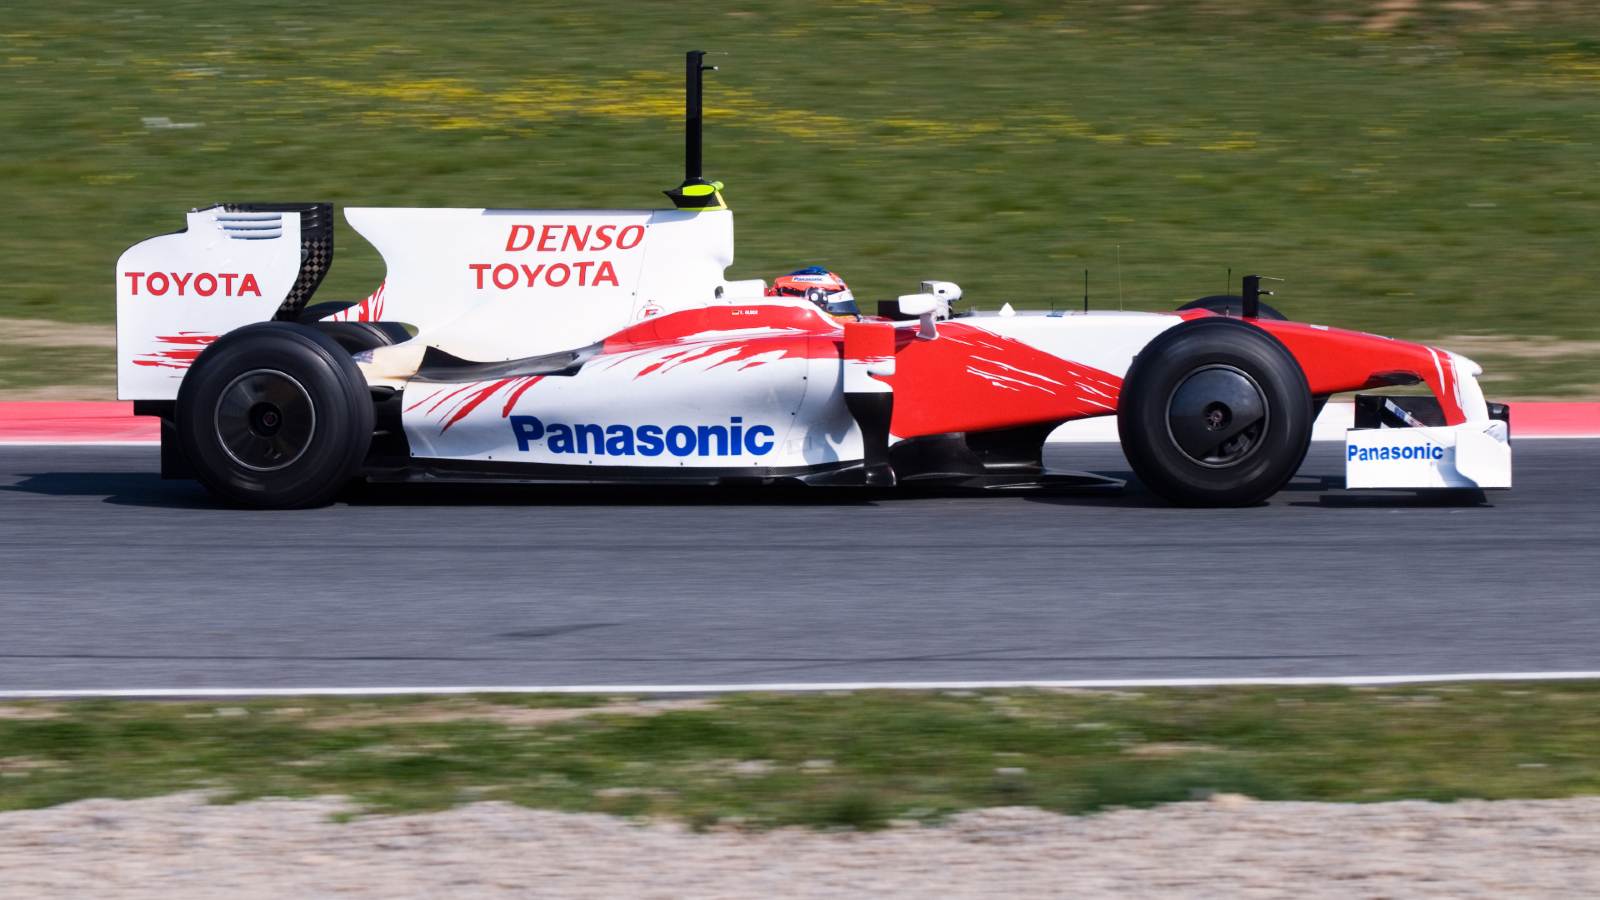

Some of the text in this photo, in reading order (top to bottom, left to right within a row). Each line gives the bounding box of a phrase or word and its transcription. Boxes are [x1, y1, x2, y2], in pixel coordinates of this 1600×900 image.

[505, 225, 645, 252] DENSO
[125, 272, 262, 297] TOYOTA
[469, 261, 619, 290] TOYOTA
[509, 415, 775, 457] Panasonic
[1347, 443, 1444, 462] Panasonic
